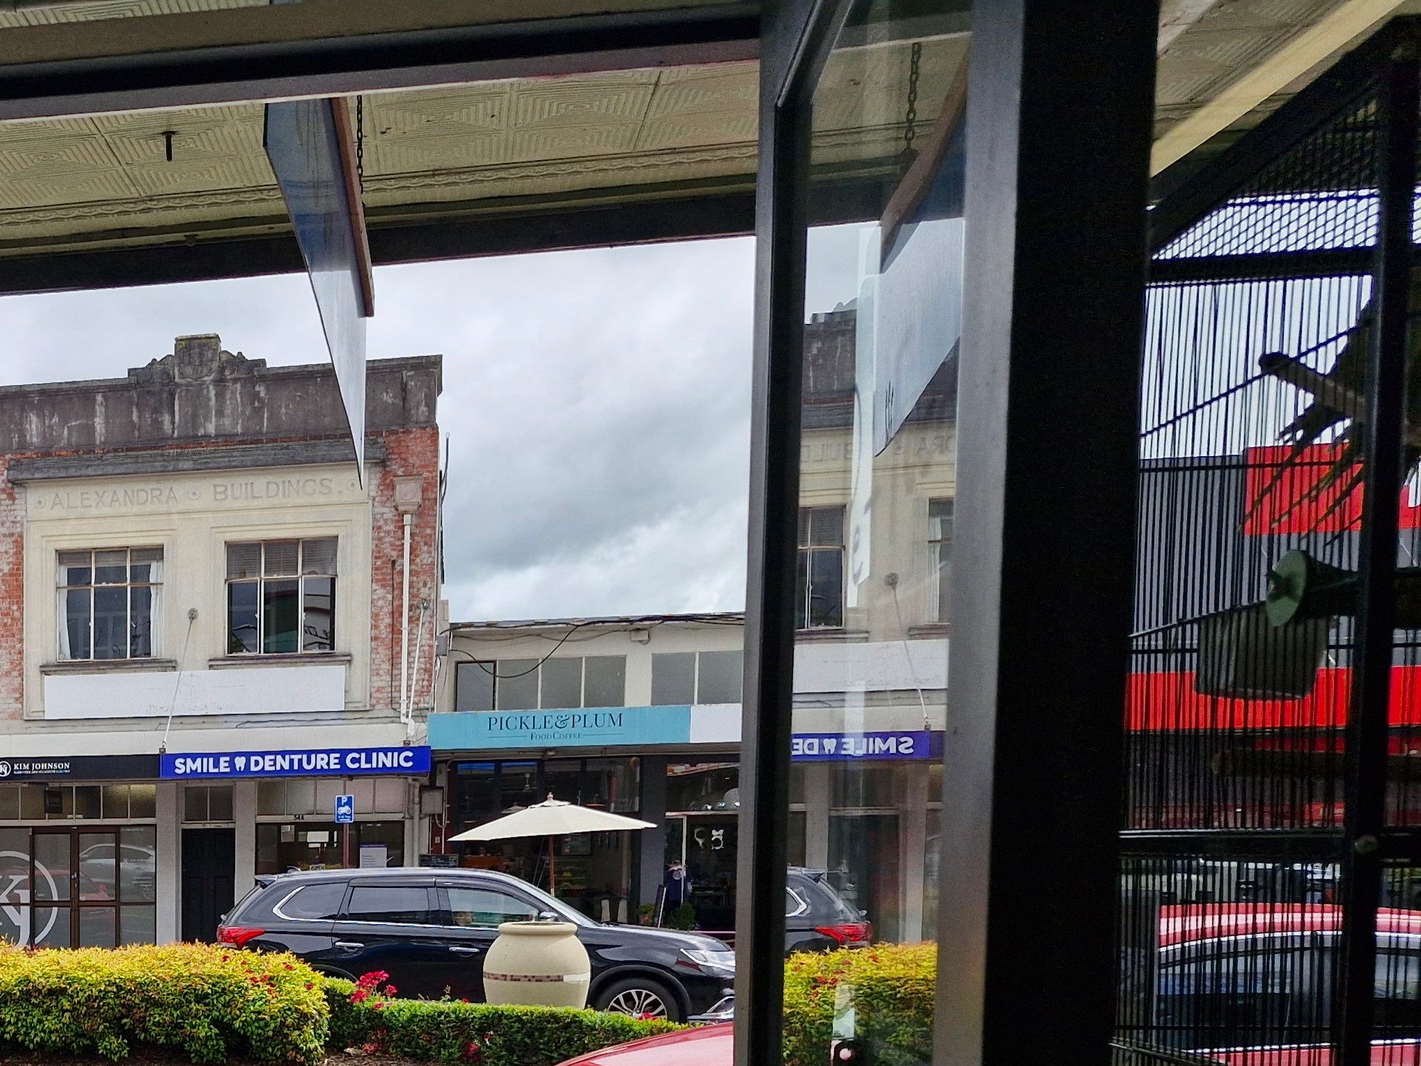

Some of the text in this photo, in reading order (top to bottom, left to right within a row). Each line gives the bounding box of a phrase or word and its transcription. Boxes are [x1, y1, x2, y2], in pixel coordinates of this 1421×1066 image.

[50, 488, 178, 510] ALEXANDRA
[32, 762, 70, 770] JOHNSON
[174, 751, 414, 774] SMILE DENTURE CLINIC
[342, 797, 347, 805] P
